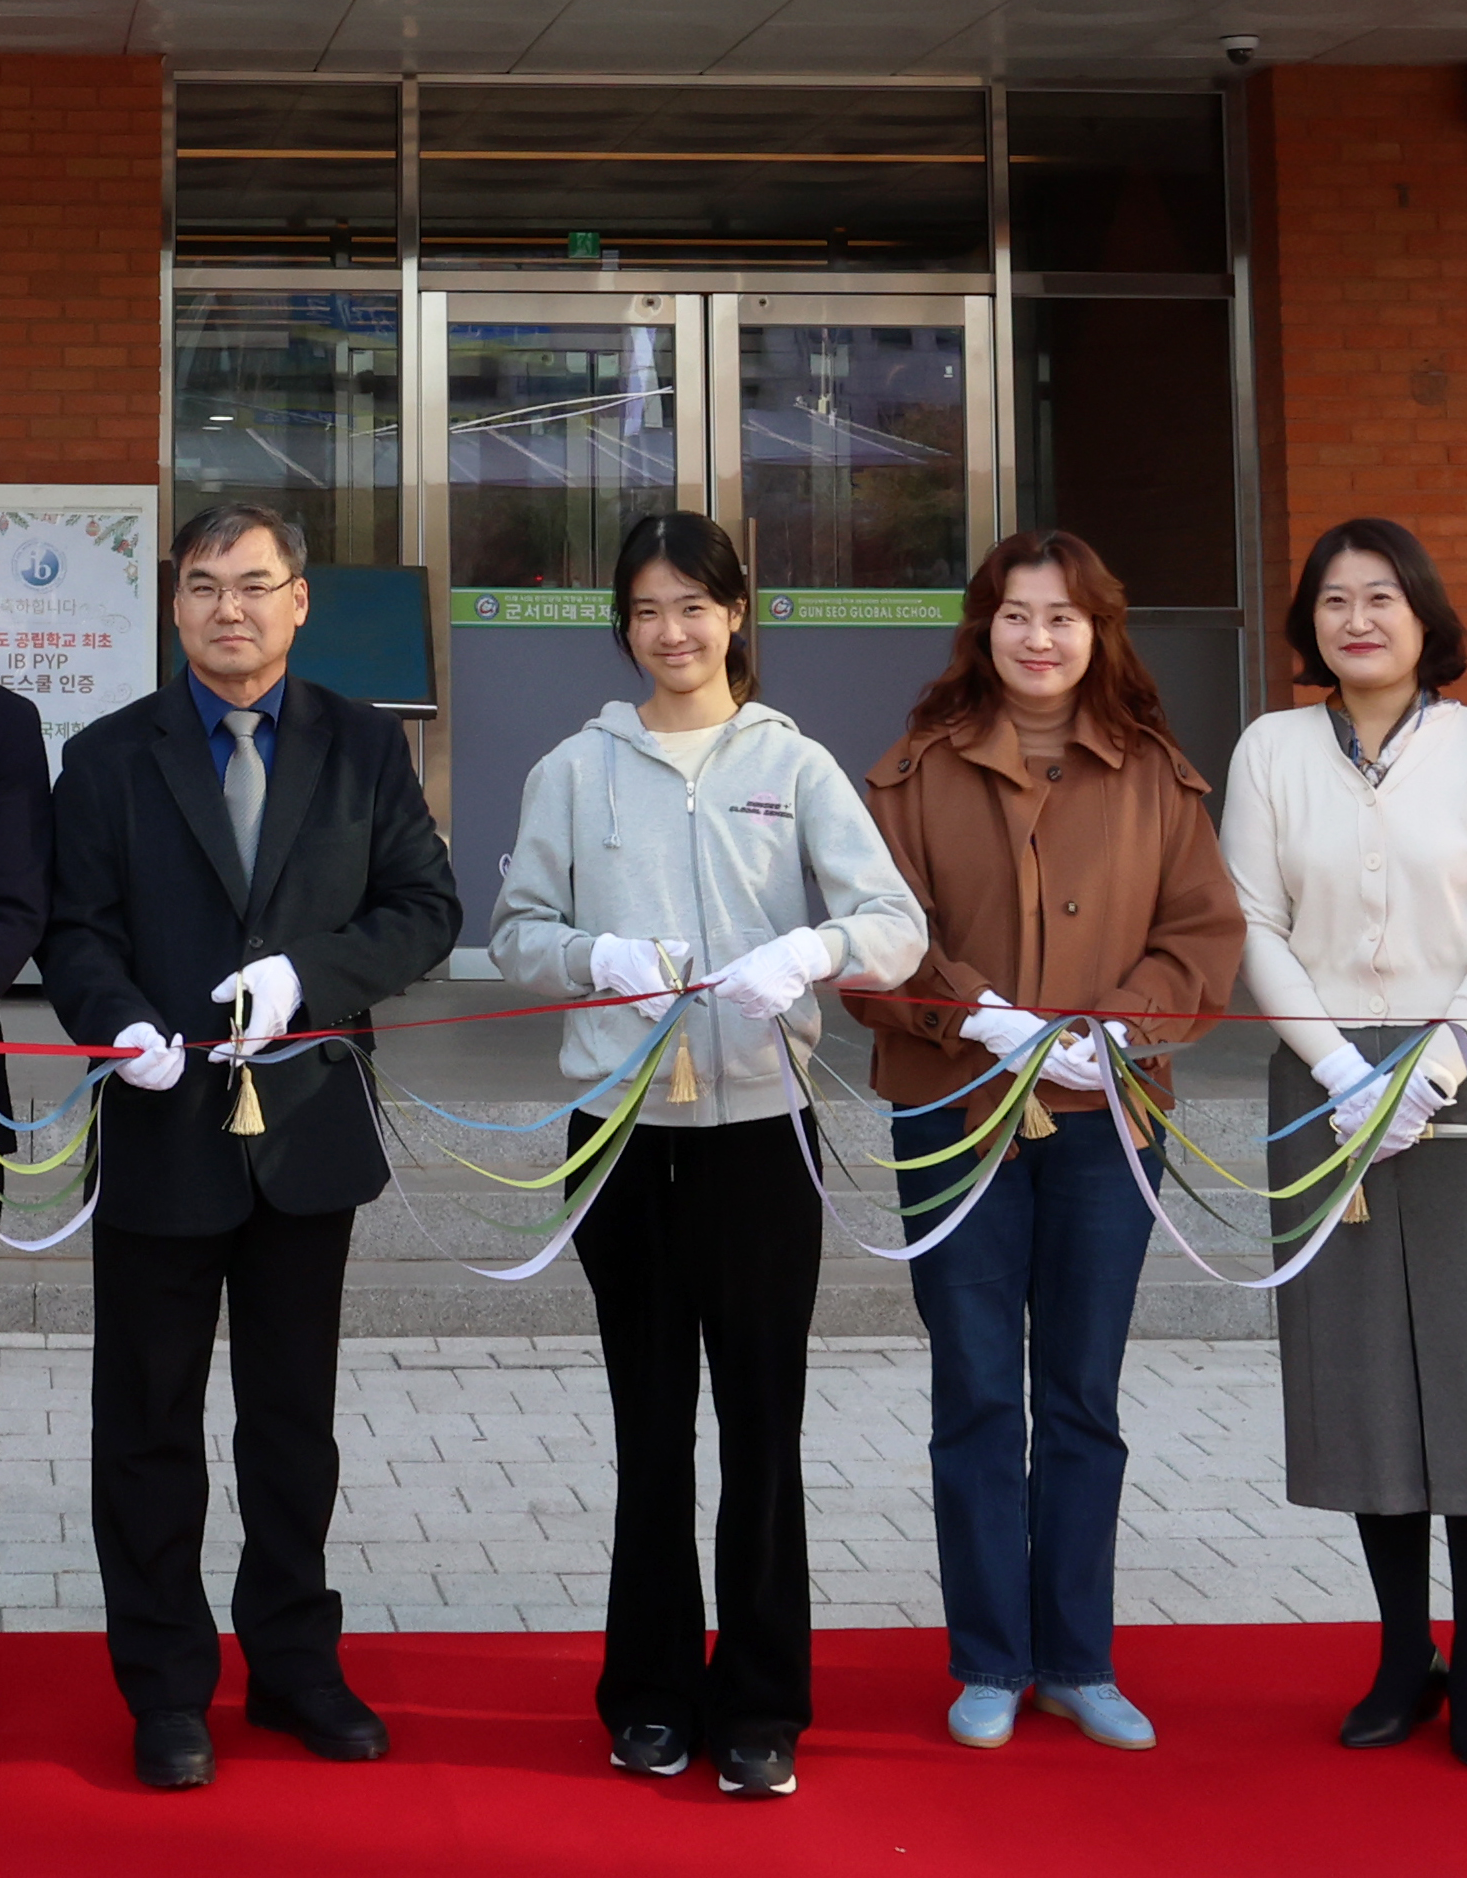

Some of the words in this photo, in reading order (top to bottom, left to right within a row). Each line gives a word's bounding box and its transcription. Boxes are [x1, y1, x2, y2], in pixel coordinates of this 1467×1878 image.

[799, 606, 823, 618] GUN
[826, 606, 847, 618] SEO
[850, 606, 893, 618] GLOBAL
[896, 606, 943, 619] SCHOOL
[15, 632, 77, 649] 공립학교
[82, 633, 113, 649] 최초
[8, 653, 26, 669] IB
[33, 653, 69, 670] PYP
[59, 674, 95, 694] 인증
